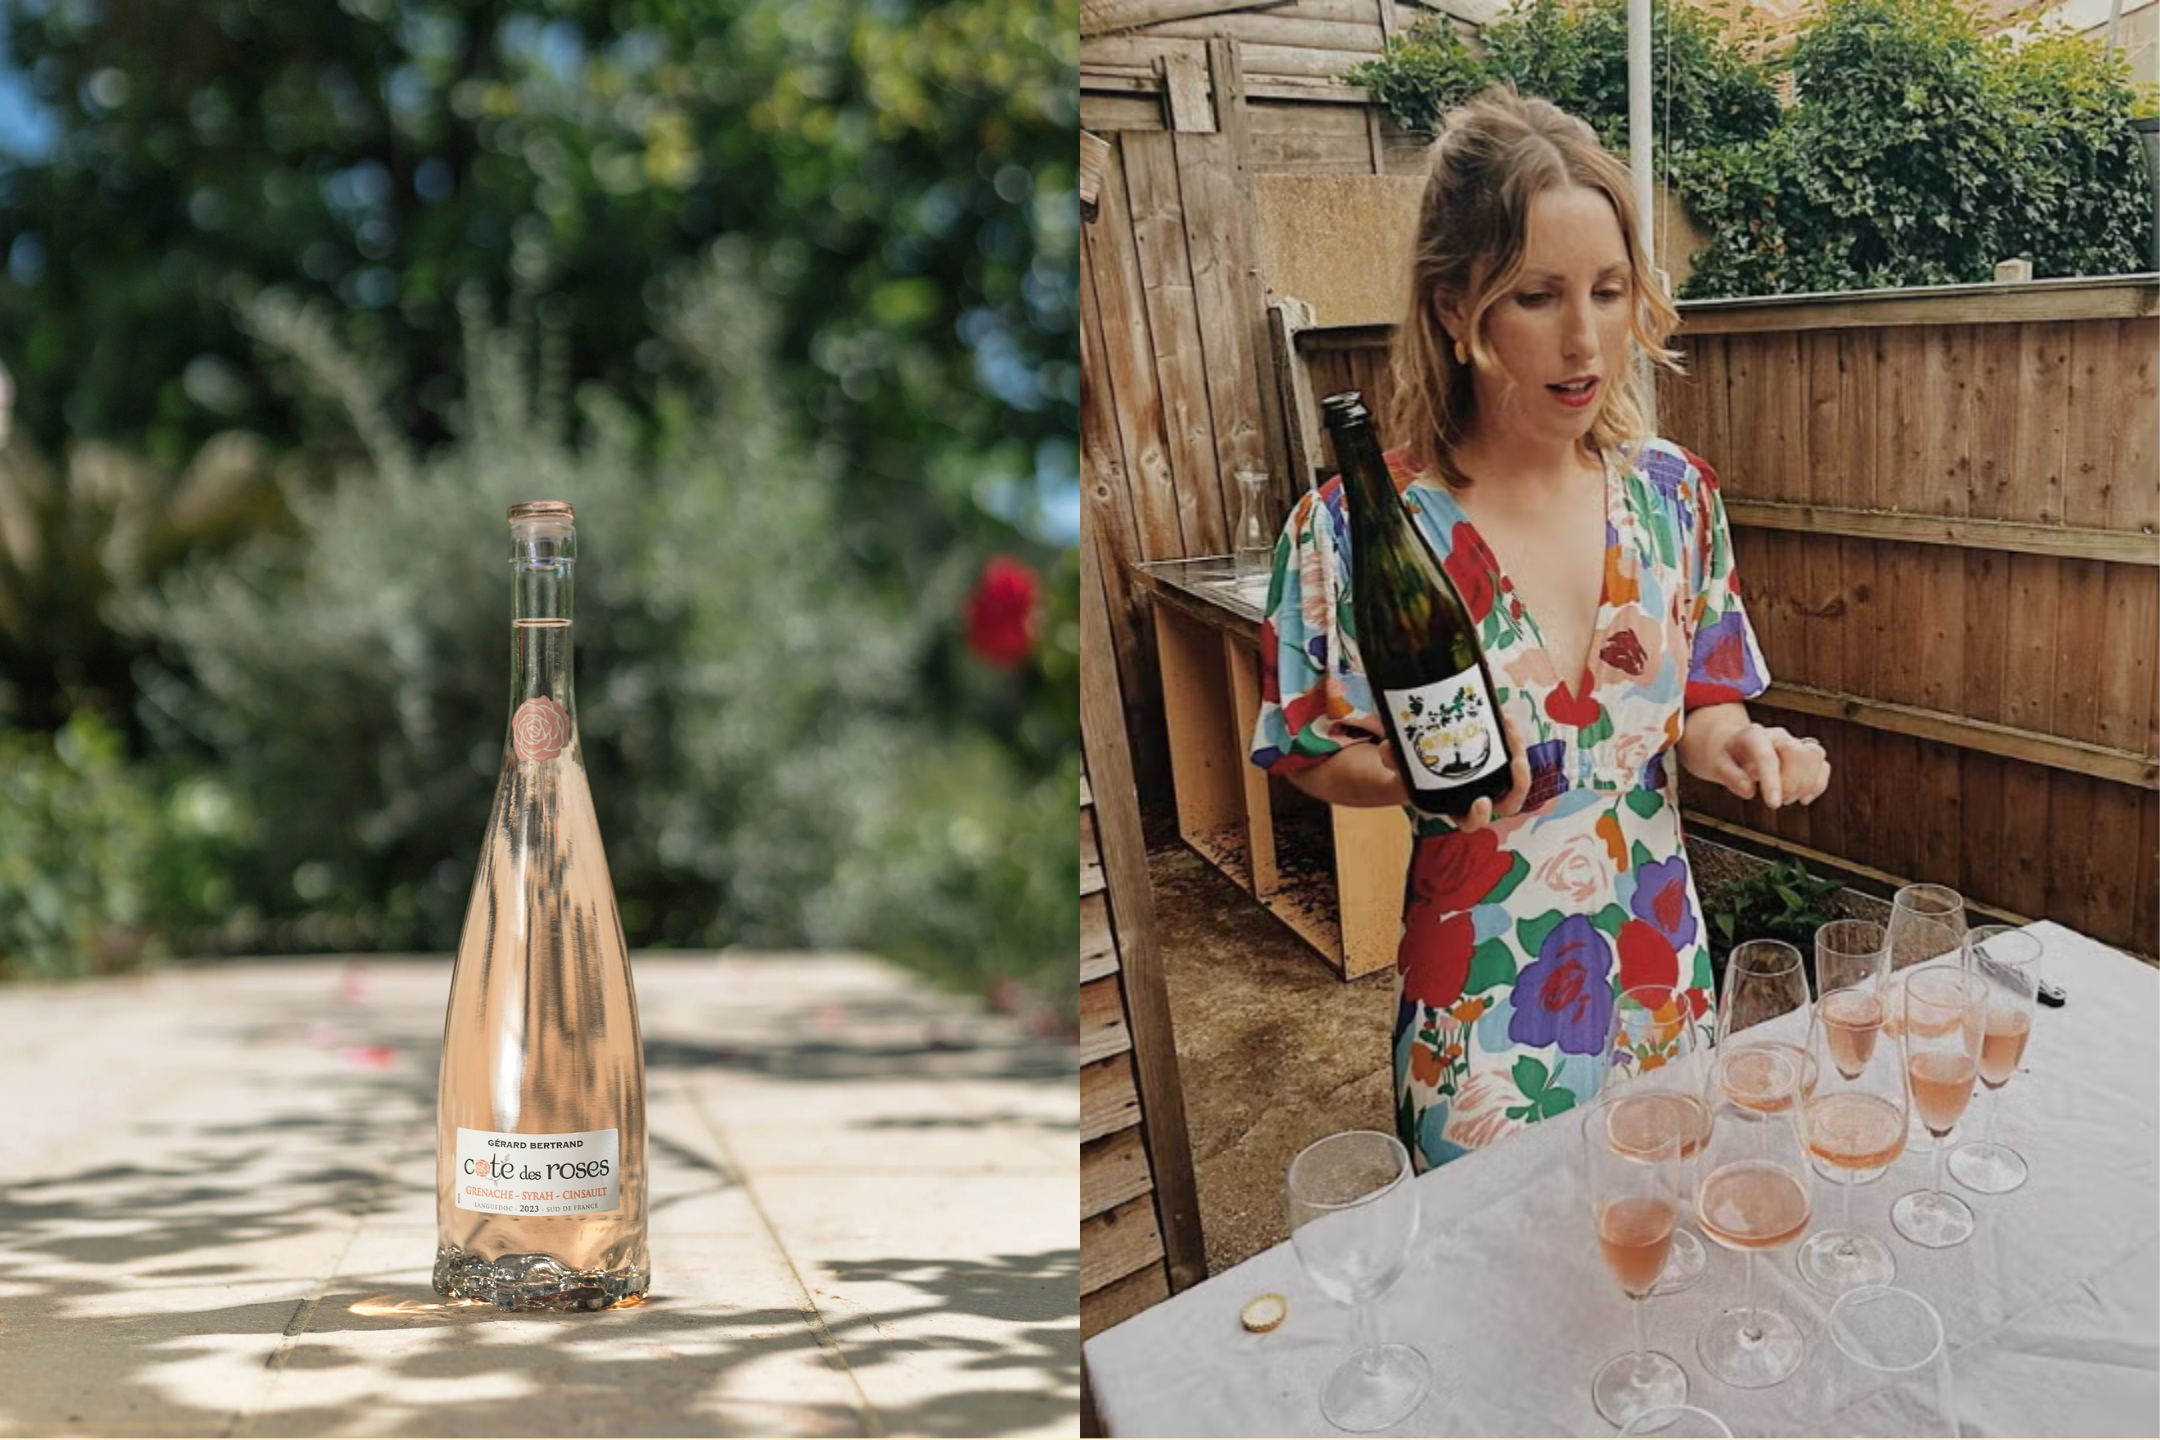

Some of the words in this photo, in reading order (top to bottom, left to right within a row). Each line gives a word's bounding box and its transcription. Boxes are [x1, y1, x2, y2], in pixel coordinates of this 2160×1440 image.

[488, 1138, 527, 1149] GÉRARD
[530, 1140, 584, 1149] BERTRAND
[519, 1165, 542, 1181] des
[545, 1159, 610, 1180] roses
[465, 1185, 514, 1200] GRENACHE
[521, 1191, 554, 1201] SYRAH
[562, 1186, 607, 1200] CINSAULT
[474, 1202, 513, 1212] LANGUEDOC
[519, 1204, 539, 1213] 2023
[573, 1203, 599, 1211] FRANCE
